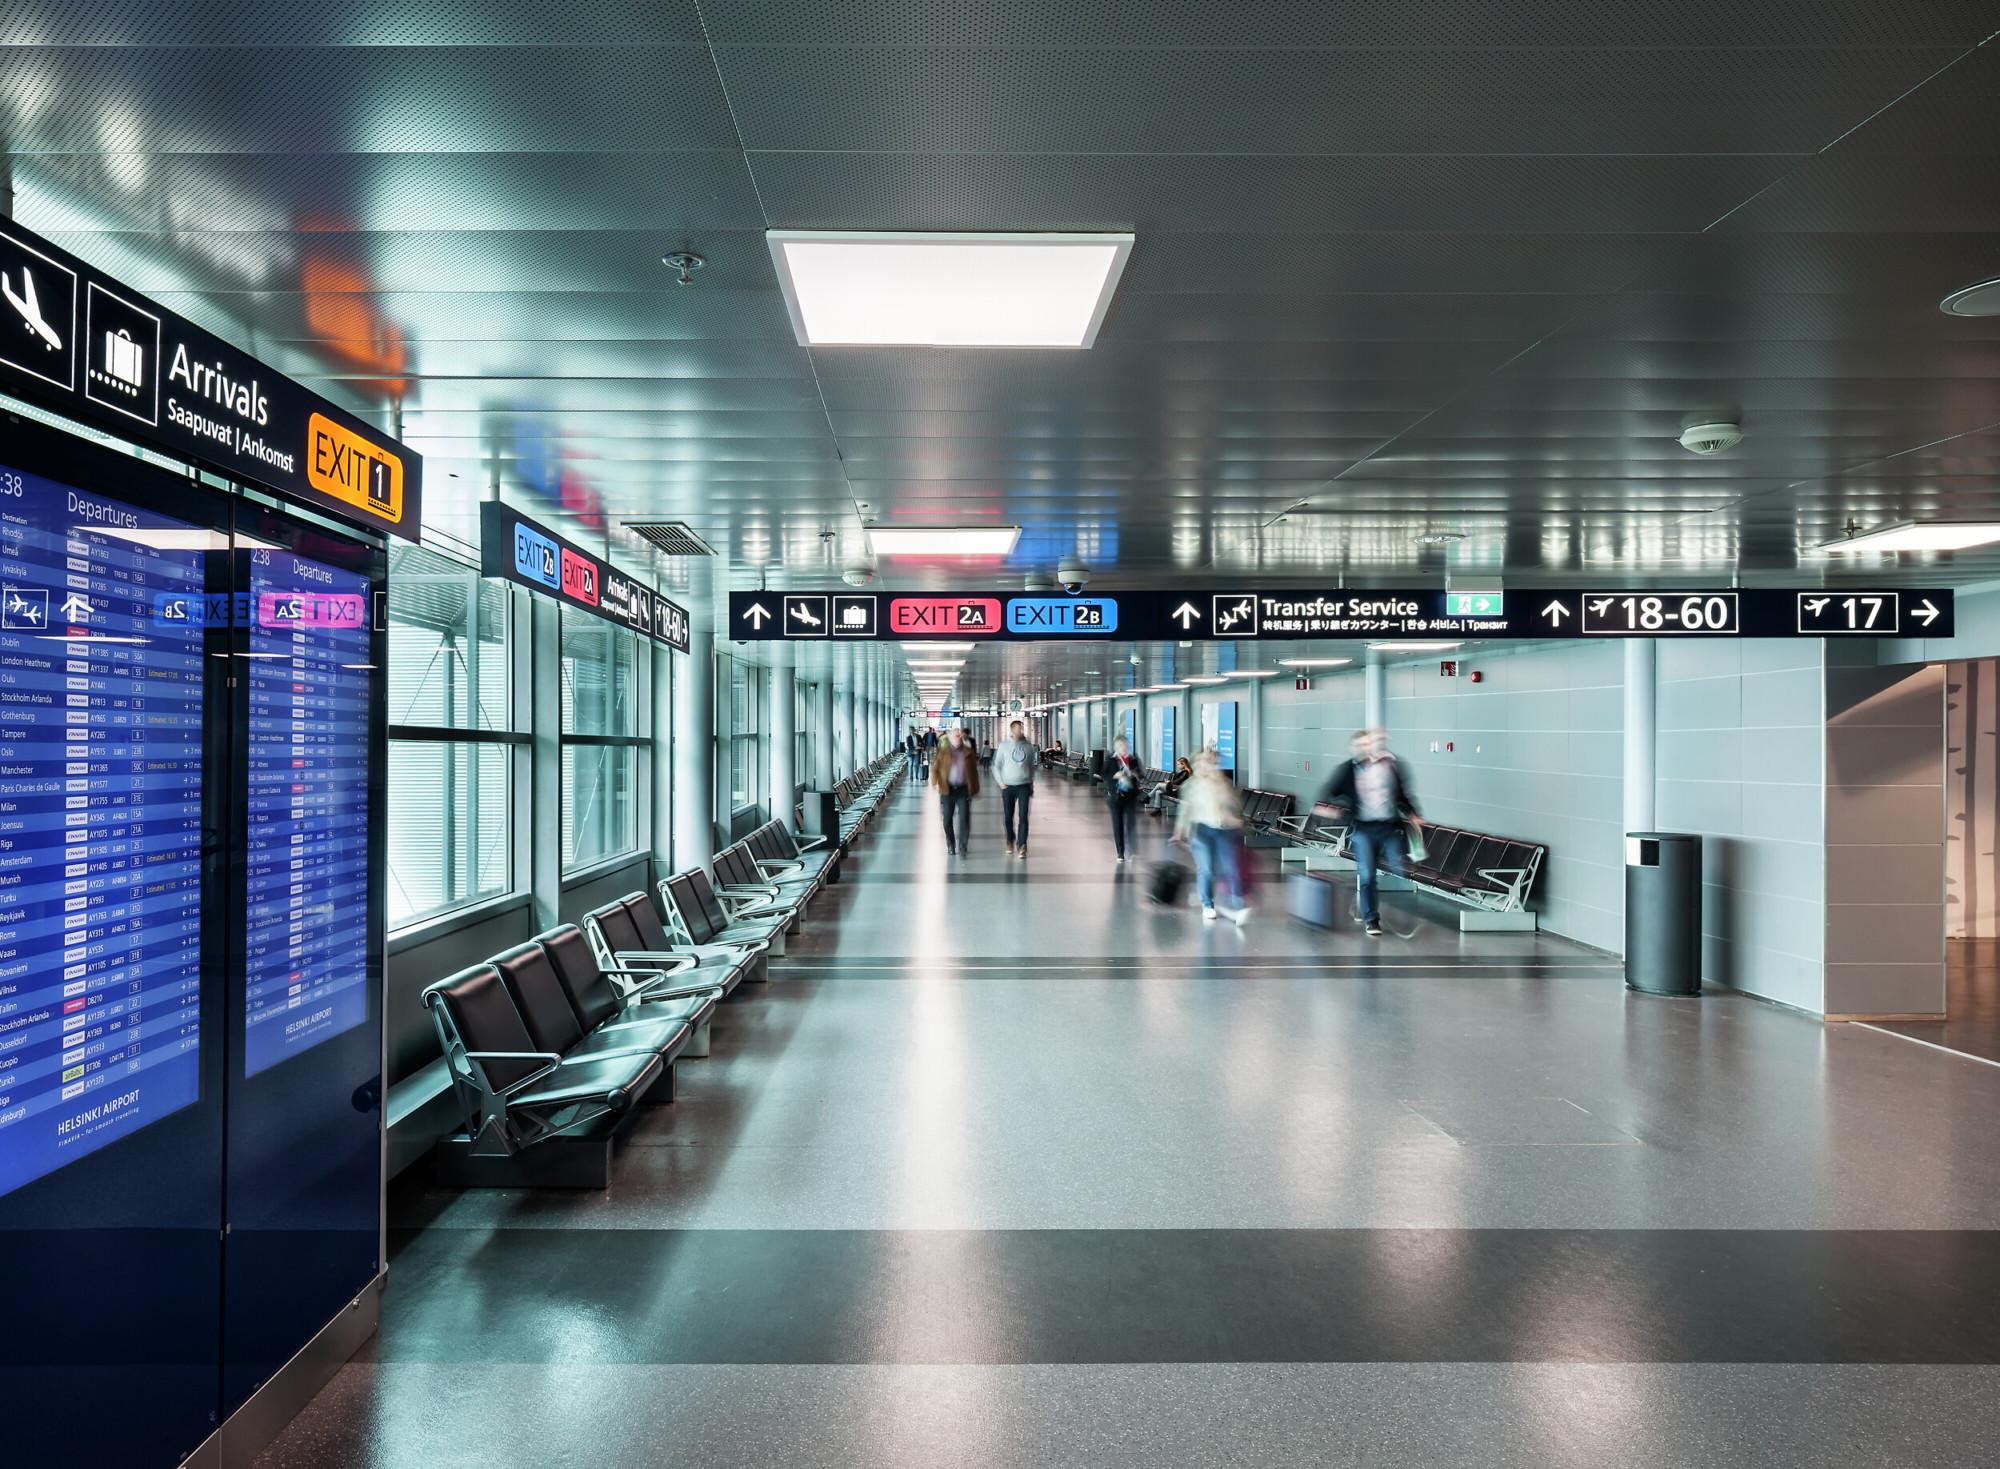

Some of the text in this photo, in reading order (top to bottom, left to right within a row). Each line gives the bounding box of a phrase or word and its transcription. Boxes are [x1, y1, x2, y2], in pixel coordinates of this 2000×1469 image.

[169, 343, 268, 426] Arrivals
[168, 398, 294, 473] Saapuvat Ankomst
[315, 432, 383, 498] EXIT 1
[68, 491, 138, 529] Departures
[518, 535, 554, 576] EXIT 2B
[293, 559, 332, 584] Departures
[564, 559, 593, 594] EXIT 2A
[1262, 597, 1419, 617] Transfer Service
[1621, 597, 1728, 630] 18-60
[1842, 598, 1883, 629] 17
[899, 606, 984, 626] EXIT 2A
[1015, 605, 1100, 626] EXIT 2B
[662, 605, 681, 643] 18-60
[1467, 620, 1508, 632] Транзит
[2, 637, 20, 647] Dublin
[1, 656, 23, 666] London
[24, 657, 51, 669] Heathrow
[1, 674, 16, 683] Oulu
[1, 692, 30, 703] Stockholm
[32, 694, 52, 704] Arlanda
[1, 711, 35, 722] Gothenburg
[1, 729, 26, 740] Tampere
[1, 748, 14, 756] Oslo
[1, 765, 34, 775] Manchester
[1, 784, 15, 793] Paris
[15, 783, 35, 792] Charles
[36, 783, 43, 791] de
[0, 802, 17, 812] Milan
[0, 840, 13, 850] Riga
[0, 856, 33, 866] Amsterdam
[0, 874, 21, 885] Munich
[0, 894, 17, 904] Turku
[0, 909, 26, 923] Reykjavik
[0, 930, 16, 940] Rome
[0, 949, 16, 959] Vaasa
[28, 1010, 49, 1024] Arlanda
[285, 1017, 311, 1035] HELSINKI
[311, 1007, 332, 1024] AIRPORT
[58, 1089, 140, 1136] HELSINKI AIRPORT
